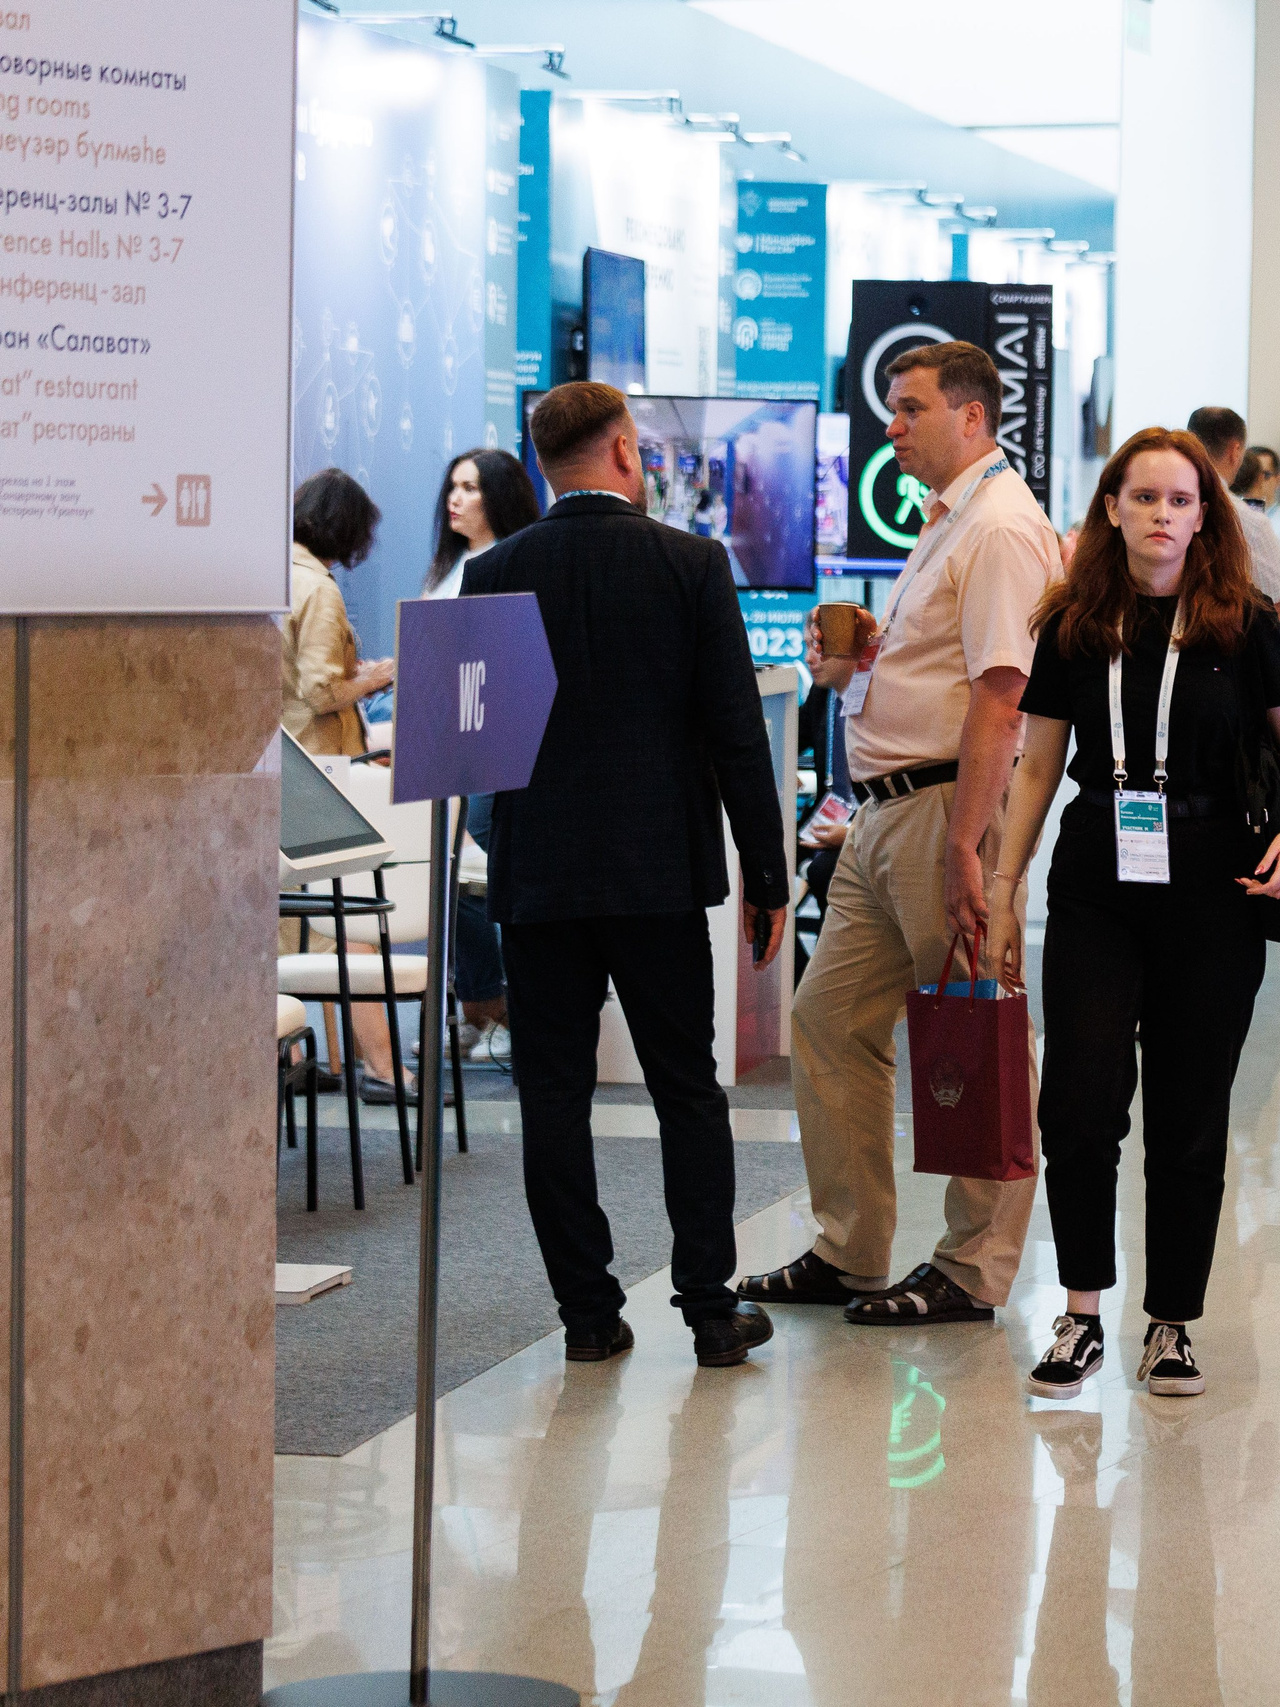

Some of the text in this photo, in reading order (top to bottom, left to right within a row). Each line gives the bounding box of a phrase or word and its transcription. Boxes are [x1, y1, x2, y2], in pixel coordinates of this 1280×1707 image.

[0, 11, 31, 31] ал
[99, 64, 187, 92] комнаты
[27, 95, 91, 120] rooms
[125, 189, 151, 217] №
[157, 192, 193, 220] 3-7
[0, 233, 53, 255] ence
[59, 229, 110, 260] Halls
[149, 235, 185, 263] 3-7
[0, 323, 151, 355] ан «Салават»
[1033, 324, 1047, 370] softline
[35, 376, 138, 401] restaurant
[1034, 384, 1047, 437] Technology
[33, 419, 136, 446] рестораны
[748, 627, 803, 658] 023
[459, 660, 486, 732] WC
